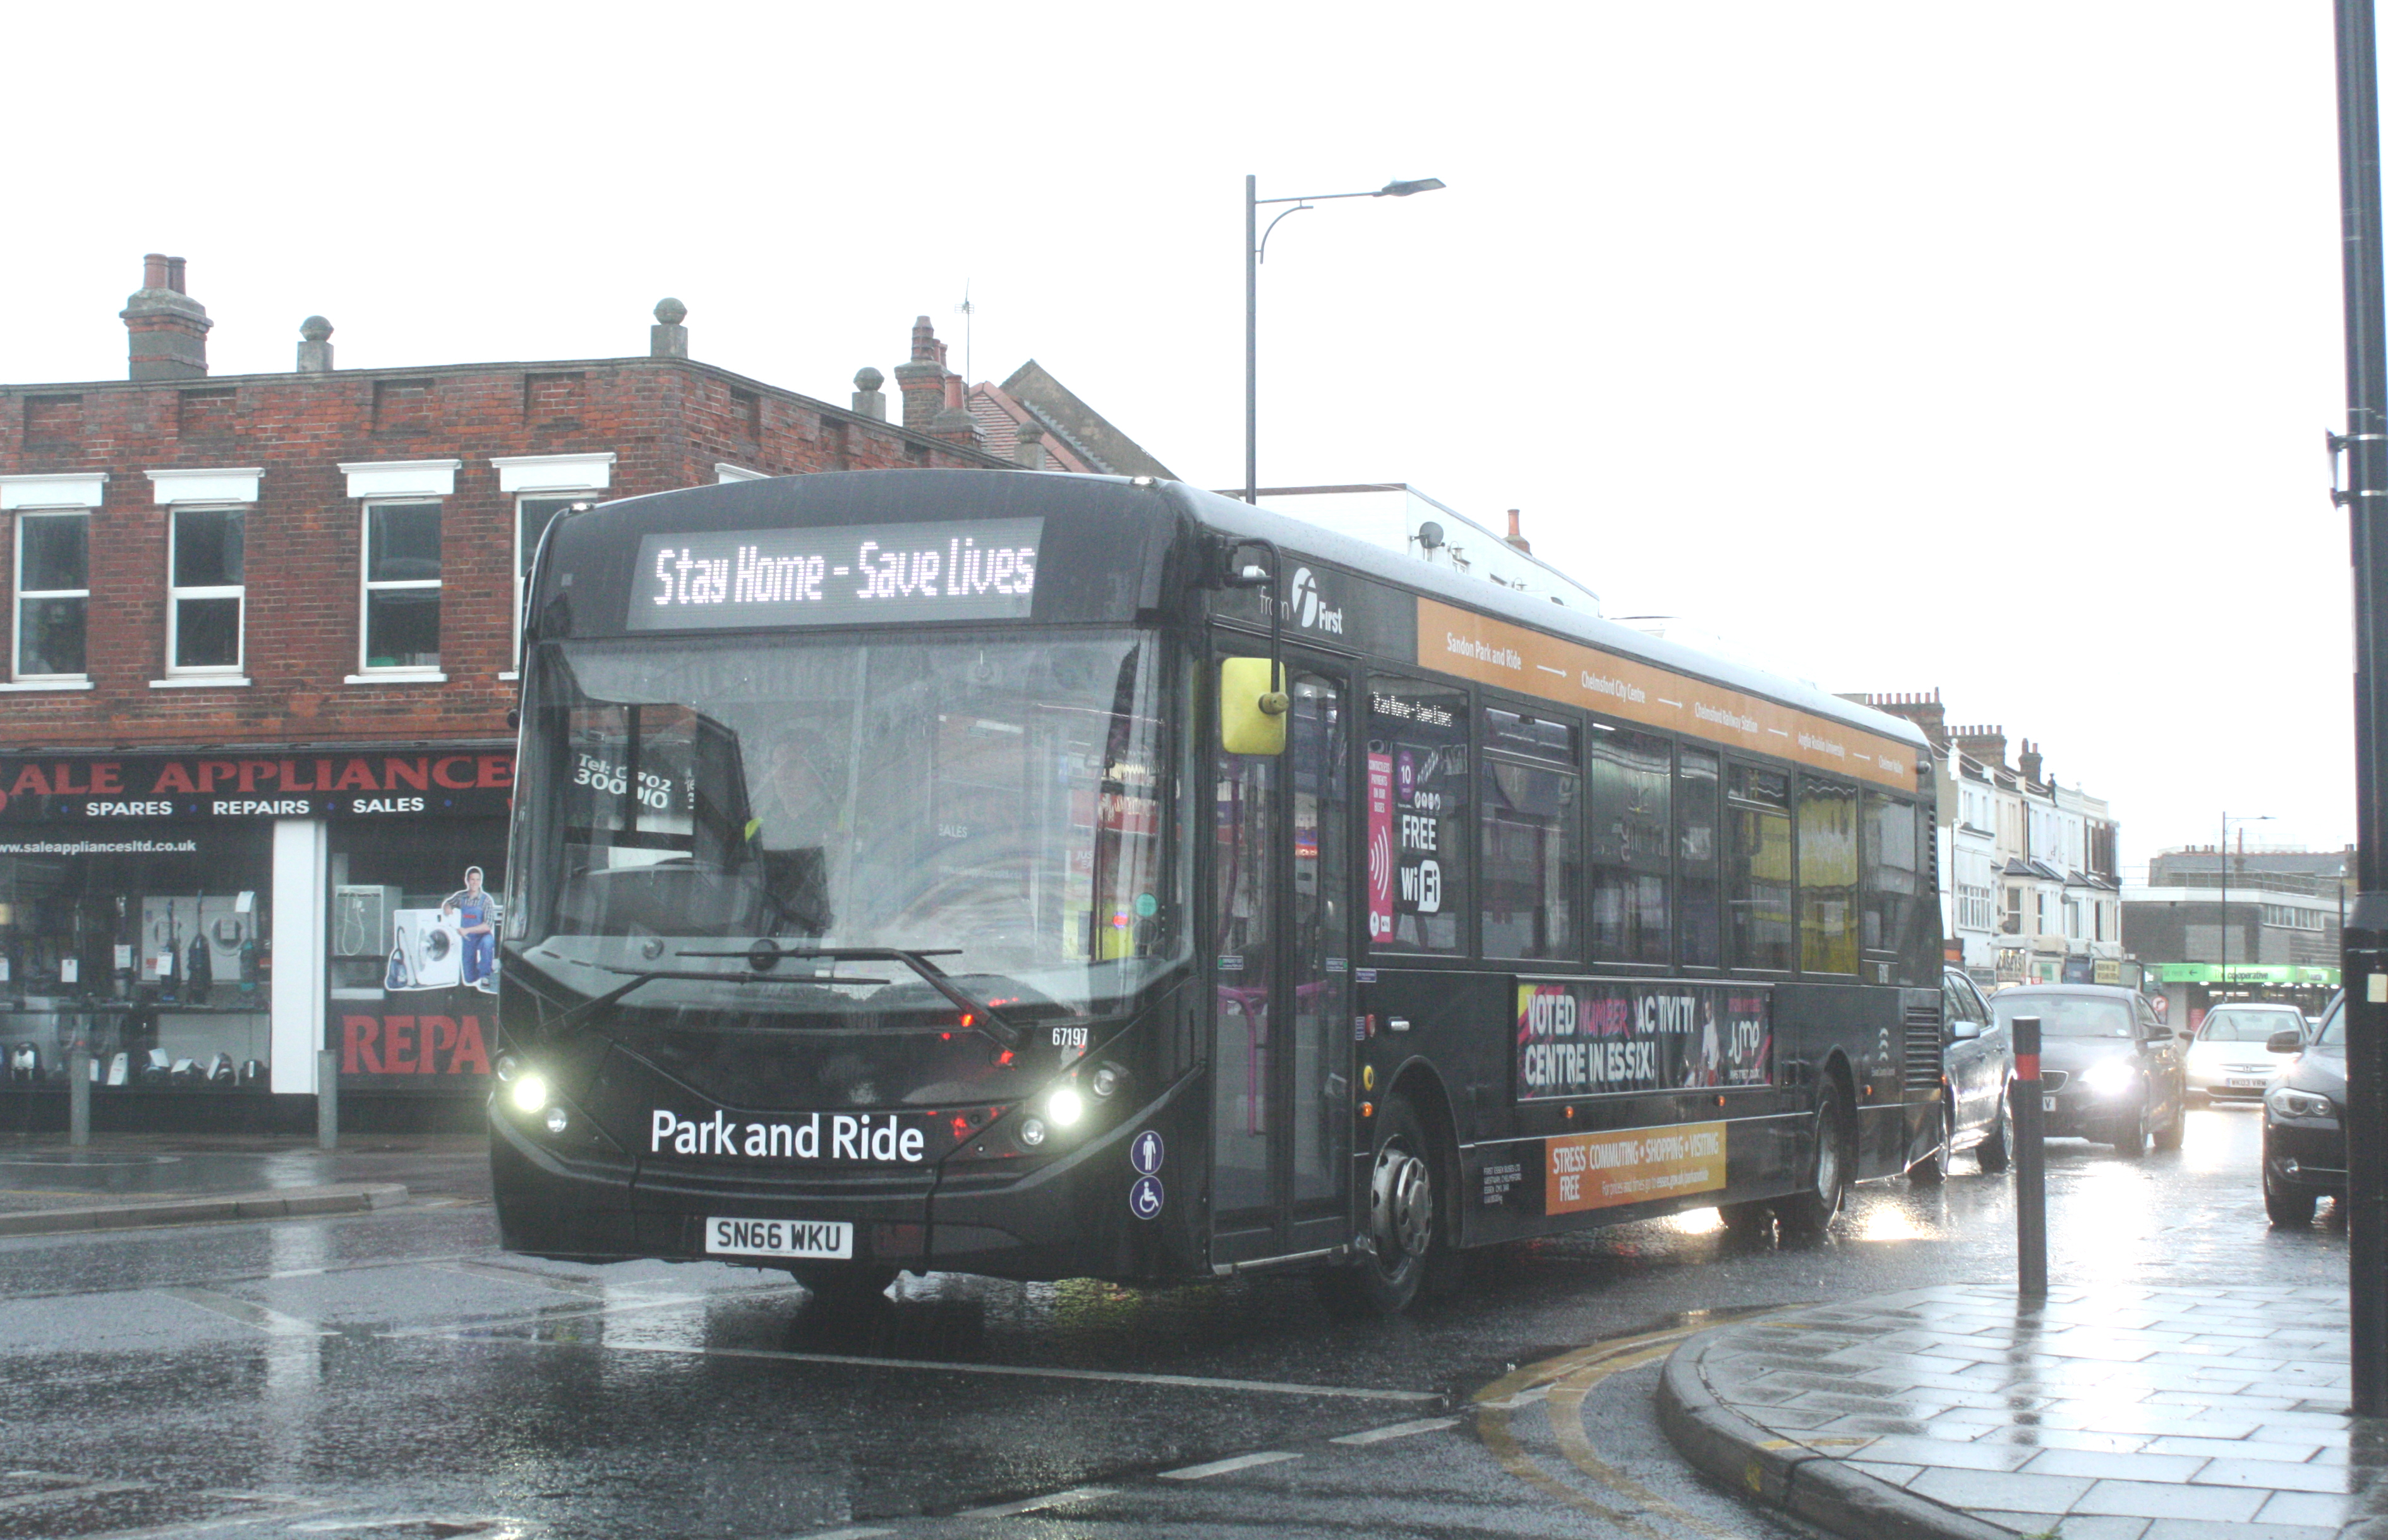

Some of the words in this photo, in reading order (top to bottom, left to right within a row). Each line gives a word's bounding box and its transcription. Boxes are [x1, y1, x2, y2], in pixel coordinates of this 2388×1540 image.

[654, 549, 728, 605] Stay
[735, 546, 824, 603] Home
[857, 542, 939, 598] Save
[948, 539, 1035, 595] Lives
[1318, 601, 1343, 635] First
[1447, 632, 1474, 658] Sandon
[1475, 641, 1492, 663] Park
[1492, 647, 1505, 666] and
[1506, 649, 1522, 670] Ride
[1581, 670, 1615, 696] Chelmsford
[1615, 681, 1627, 702] City
[1627, 683, 1646, 704] Centre
[0, 764, 125, 804] ALE
[150, 756, 516, 794] APPLIANCE
[579, 754, 611, 774] Tel:
[1401, 764, 1411, 785] 10
[85, 801, 173, 816] SPARES
[213, 799, 310, 815] REPAIRS
[352, 797, 425, 814] SALES
[1402, 814, 1437, 851] FREE
[1526, 994, 1576, 1036] VOTED
[341, 1014, 498, 1074] REPA
[1052, 1027, 1088, 1046] 67197
[1525, 1044, 1586, 1086] CENTRE
[1589, 1043, 1604, 1083] IN
[651, 1109, 738, 1155] Park
[744, 1112, 820, 1158] and
[832, 1114, 924, 1162] Ride
[1553, 1145, 1587, 1175] STRESS
[1589, 1140, 1639, 1170] COMMUTING
[1645, 1136, 1684, 1164] SHOPPING
[1689, 1131, 1720, 1158] VISITING
[1559, 1174, 1581, 1202] FREE
[717, 1221, 782, 1249] SN66
[791, 1224, 841, 1252] WKU
